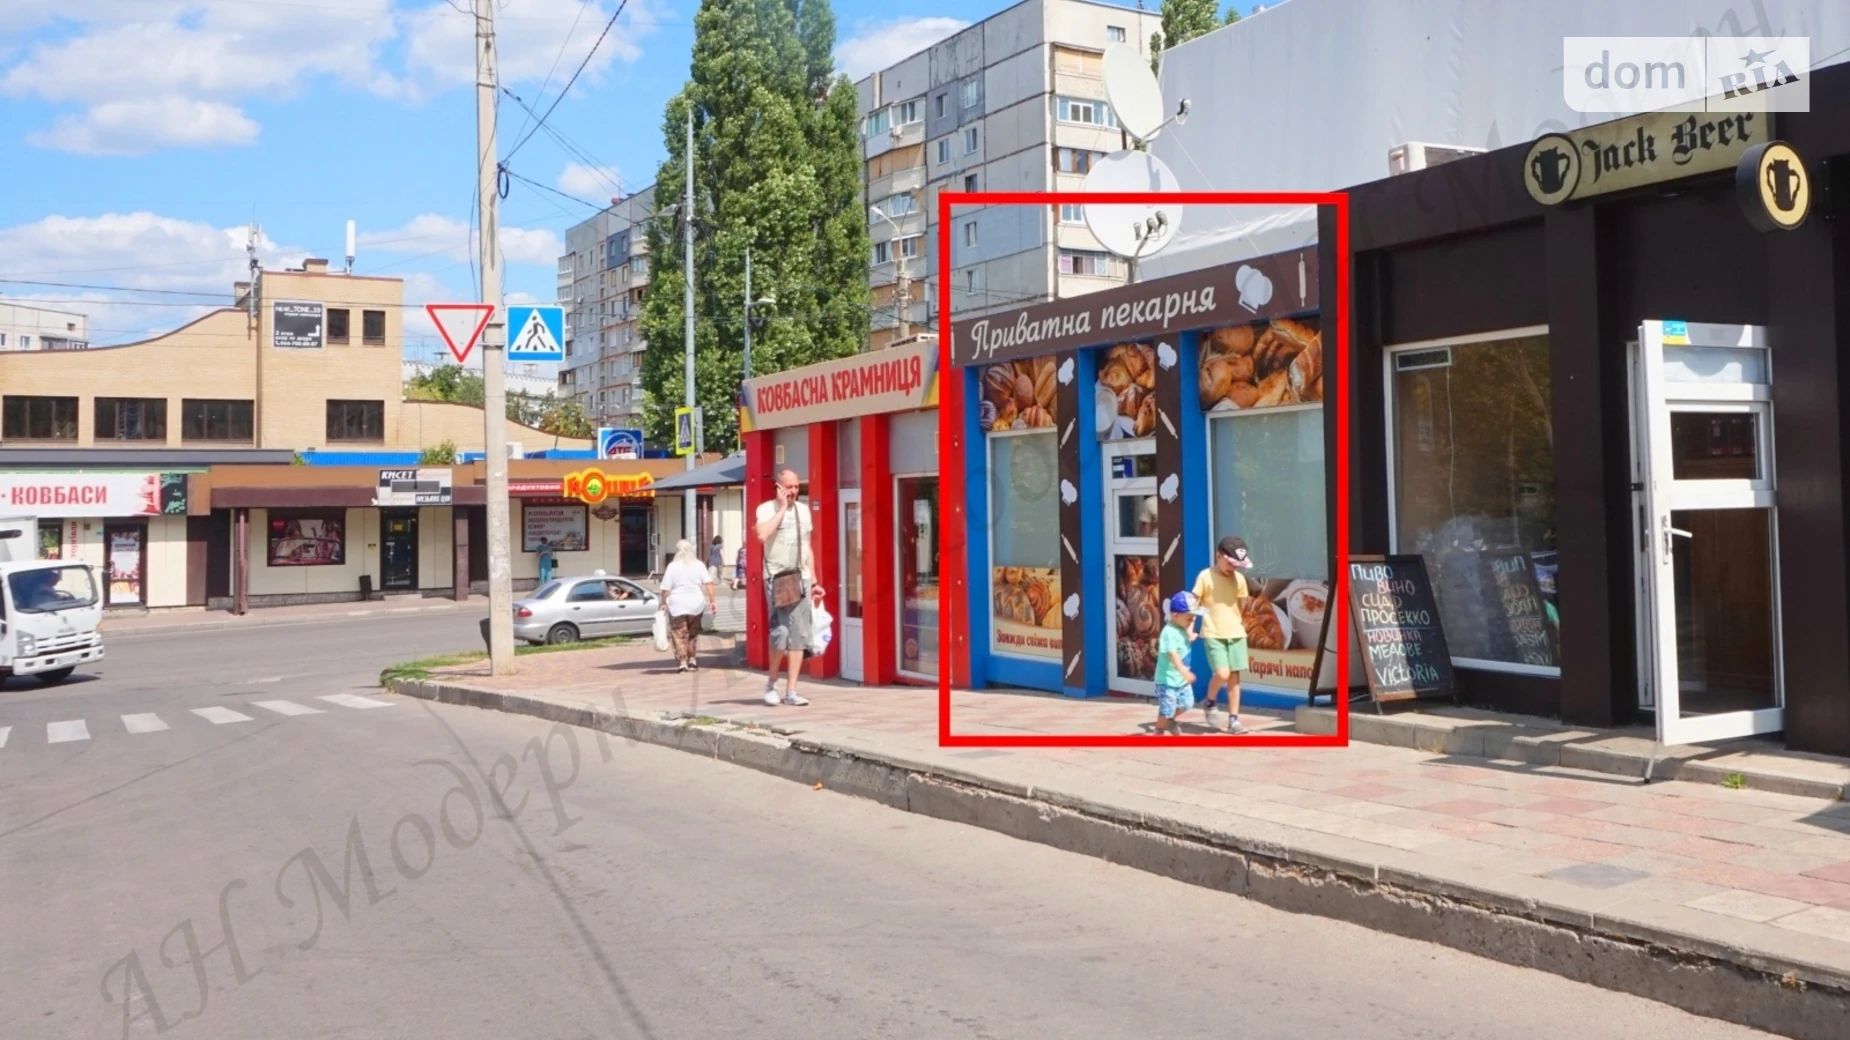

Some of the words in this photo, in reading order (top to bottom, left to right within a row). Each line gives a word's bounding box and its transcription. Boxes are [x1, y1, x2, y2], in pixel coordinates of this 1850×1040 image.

[1581, 126, 1657, 184] Jack
[1671, 112, 1754, 165] Beer
[970, 310, 1091, 359] Приватна
[1100, 285, 1217, 329] пекарня
[757, 375, 828, 414] КОВБАСНА
[831, 355, 922, 403] КРАМНИЦЯ
[381, 470, 413, 480] КИСЕТ
[11, 486, 107, 505] КОВБАСИ
[1360, 607, 1430, 627] ПРОСЕККО
[996, 629, 1025, 648] Завжди
[1249, 656, 1283, 679] Гарячі
